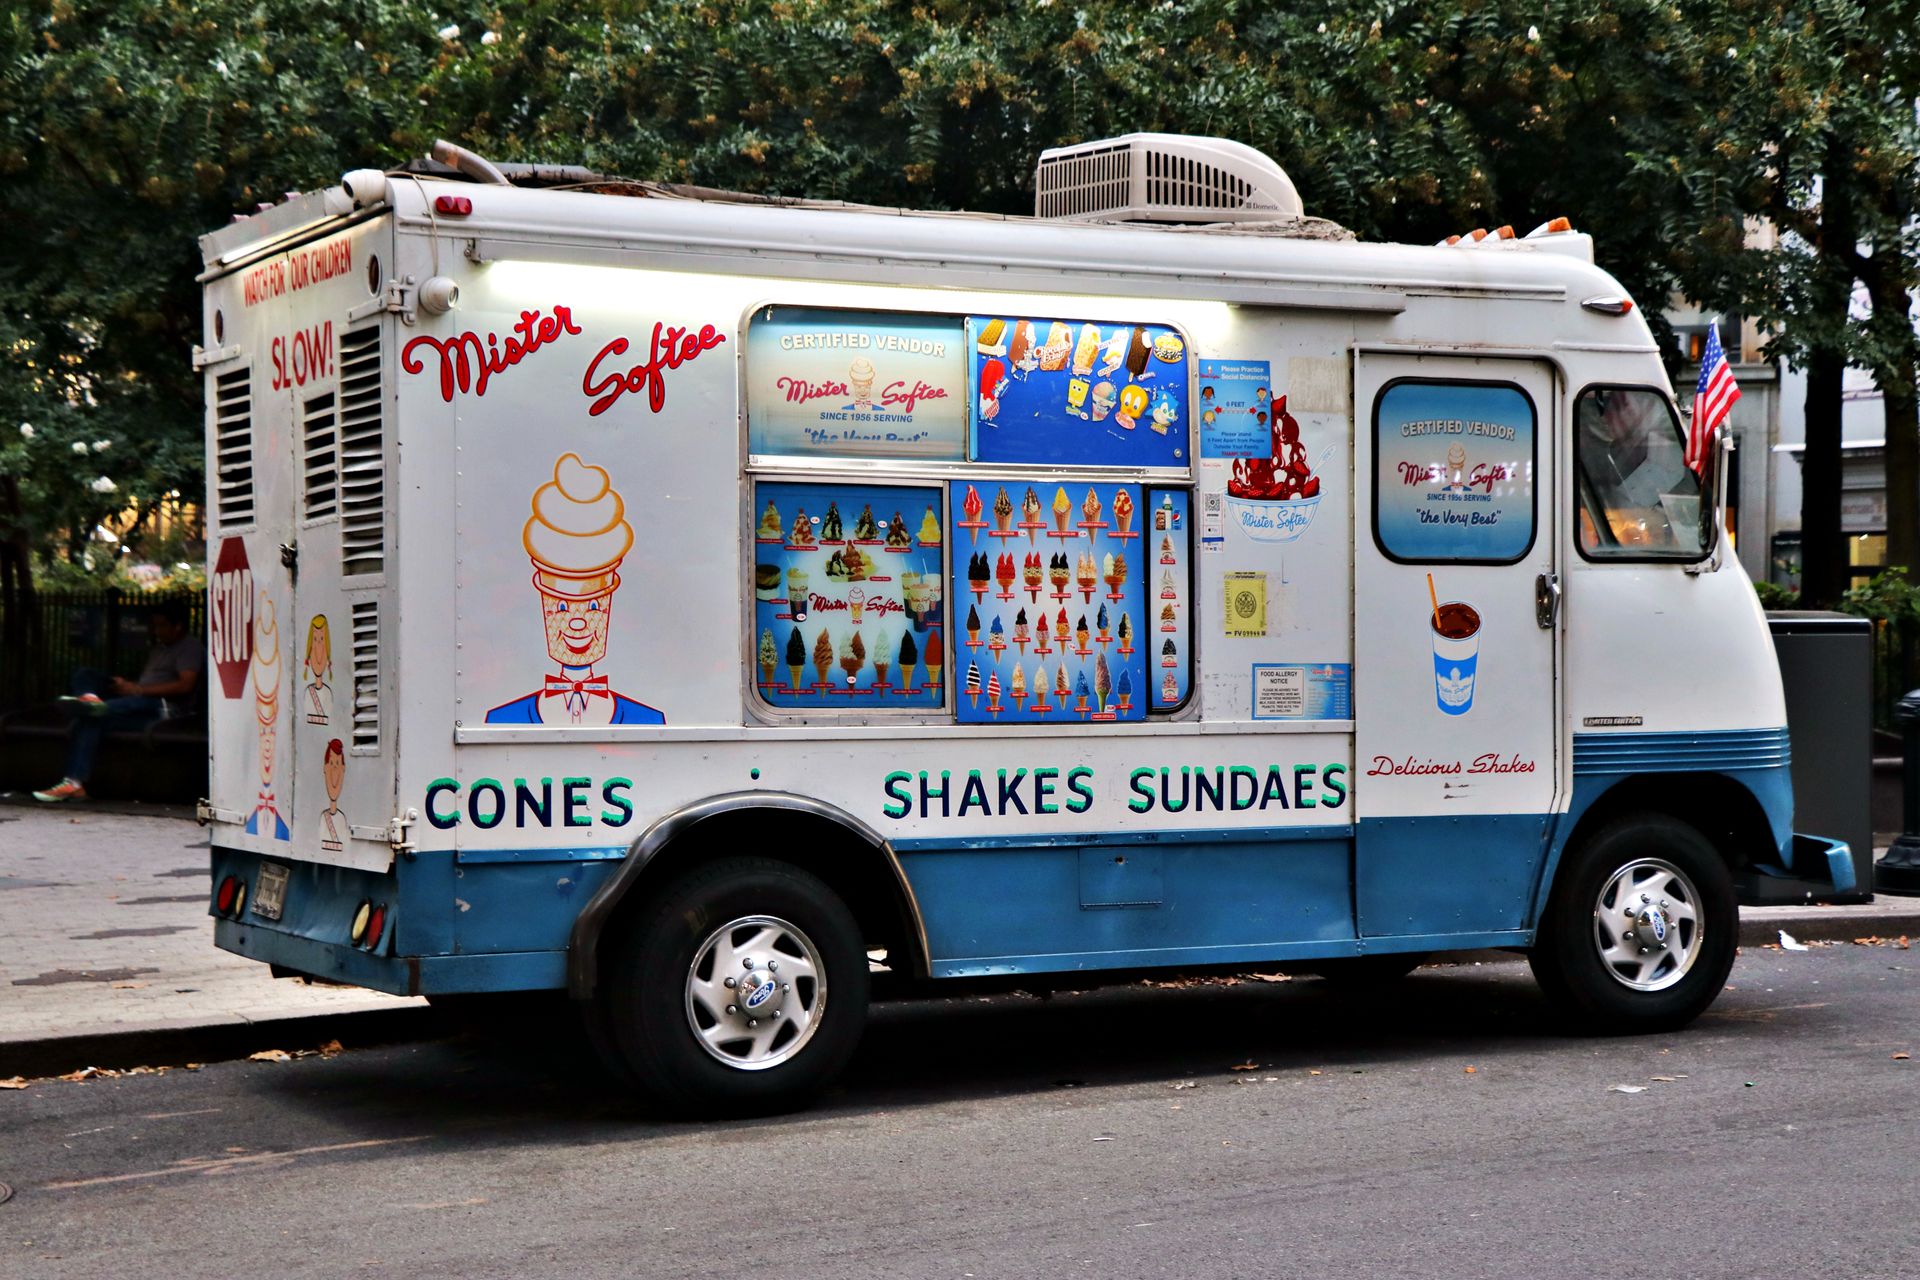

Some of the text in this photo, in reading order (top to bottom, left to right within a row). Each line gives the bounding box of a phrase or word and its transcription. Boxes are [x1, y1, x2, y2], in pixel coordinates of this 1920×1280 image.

[243, 237, 352, 307] WATCH FOR OUR CHILDREN
[271, 320, 334, 391] SLOW!
[780, 333, 946, 358] CERTIFIED VENDOR
[401, 305, 727, 416] Mister Softee
[1240, 374, 1269, 382] Distancing
[777, 376, 849, 405] Mister
[881, 379, 948, 414] Softee
[820, 412, 913, 423] SINCE 1956 SERVING
[1401, 420, 1515, 440] CERTIFIED VENDOR
[1427, 493, 1446, 501] SINCE
[1463, 494, 1491, 502] SERVING
[1242, 510, 1308, 532] Mister Softee
[1416, 508, 1501, 527] "the Very Best"
[213, 569, 252, 664] STOP
[809, 593, 905, 617] Mister Softee
[1367, 753, 1536, 776] Delicious Shakes
[424, 776, 634, 831] CONES
[883, 763, 1347, 820] SHAKES SUNDAES
